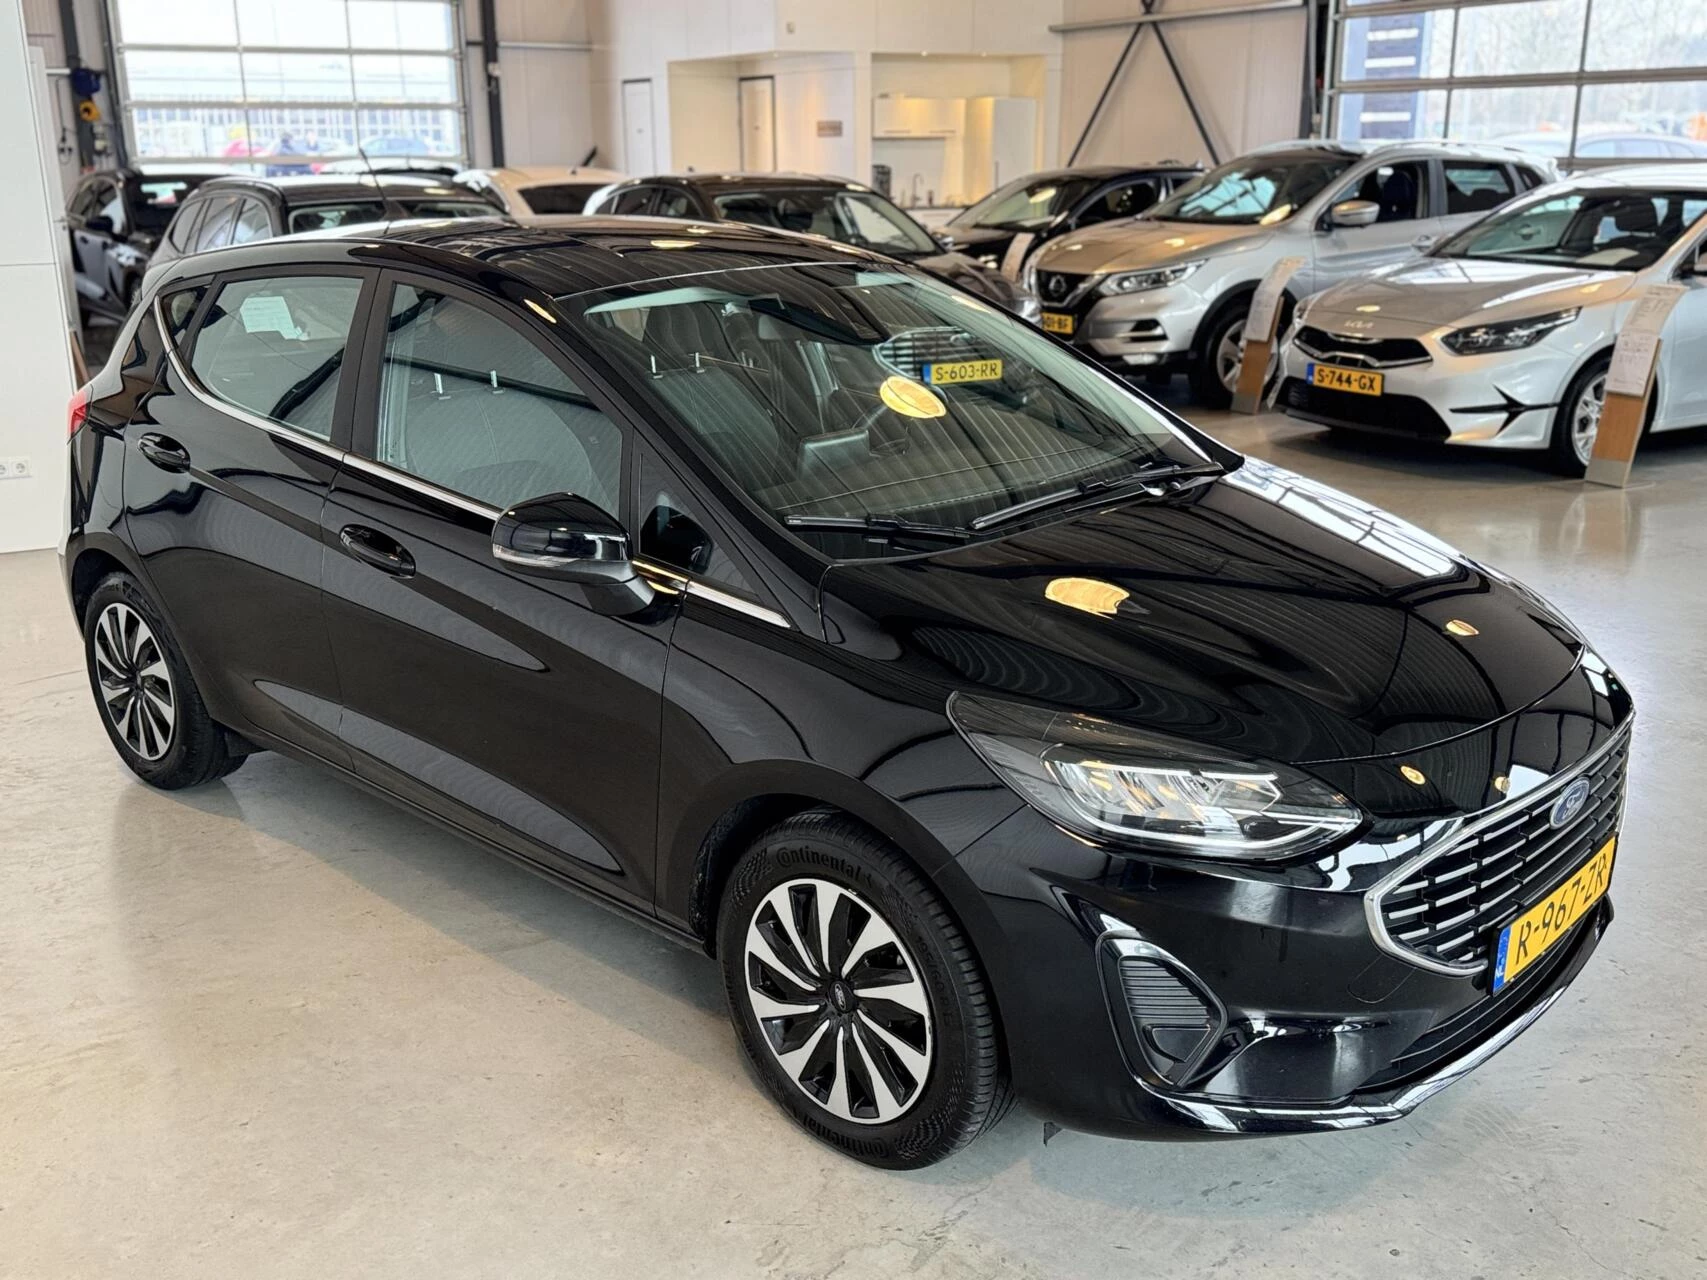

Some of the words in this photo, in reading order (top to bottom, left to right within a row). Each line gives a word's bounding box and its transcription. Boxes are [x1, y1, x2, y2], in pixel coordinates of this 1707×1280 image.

[935, 362, 998, 381] S-603-RR
[1317, 368, 1376, 392] S-744-GX
[775, 844, 862, 881] Continental
[1515, 853, 1608, 965] R-967-ZR
